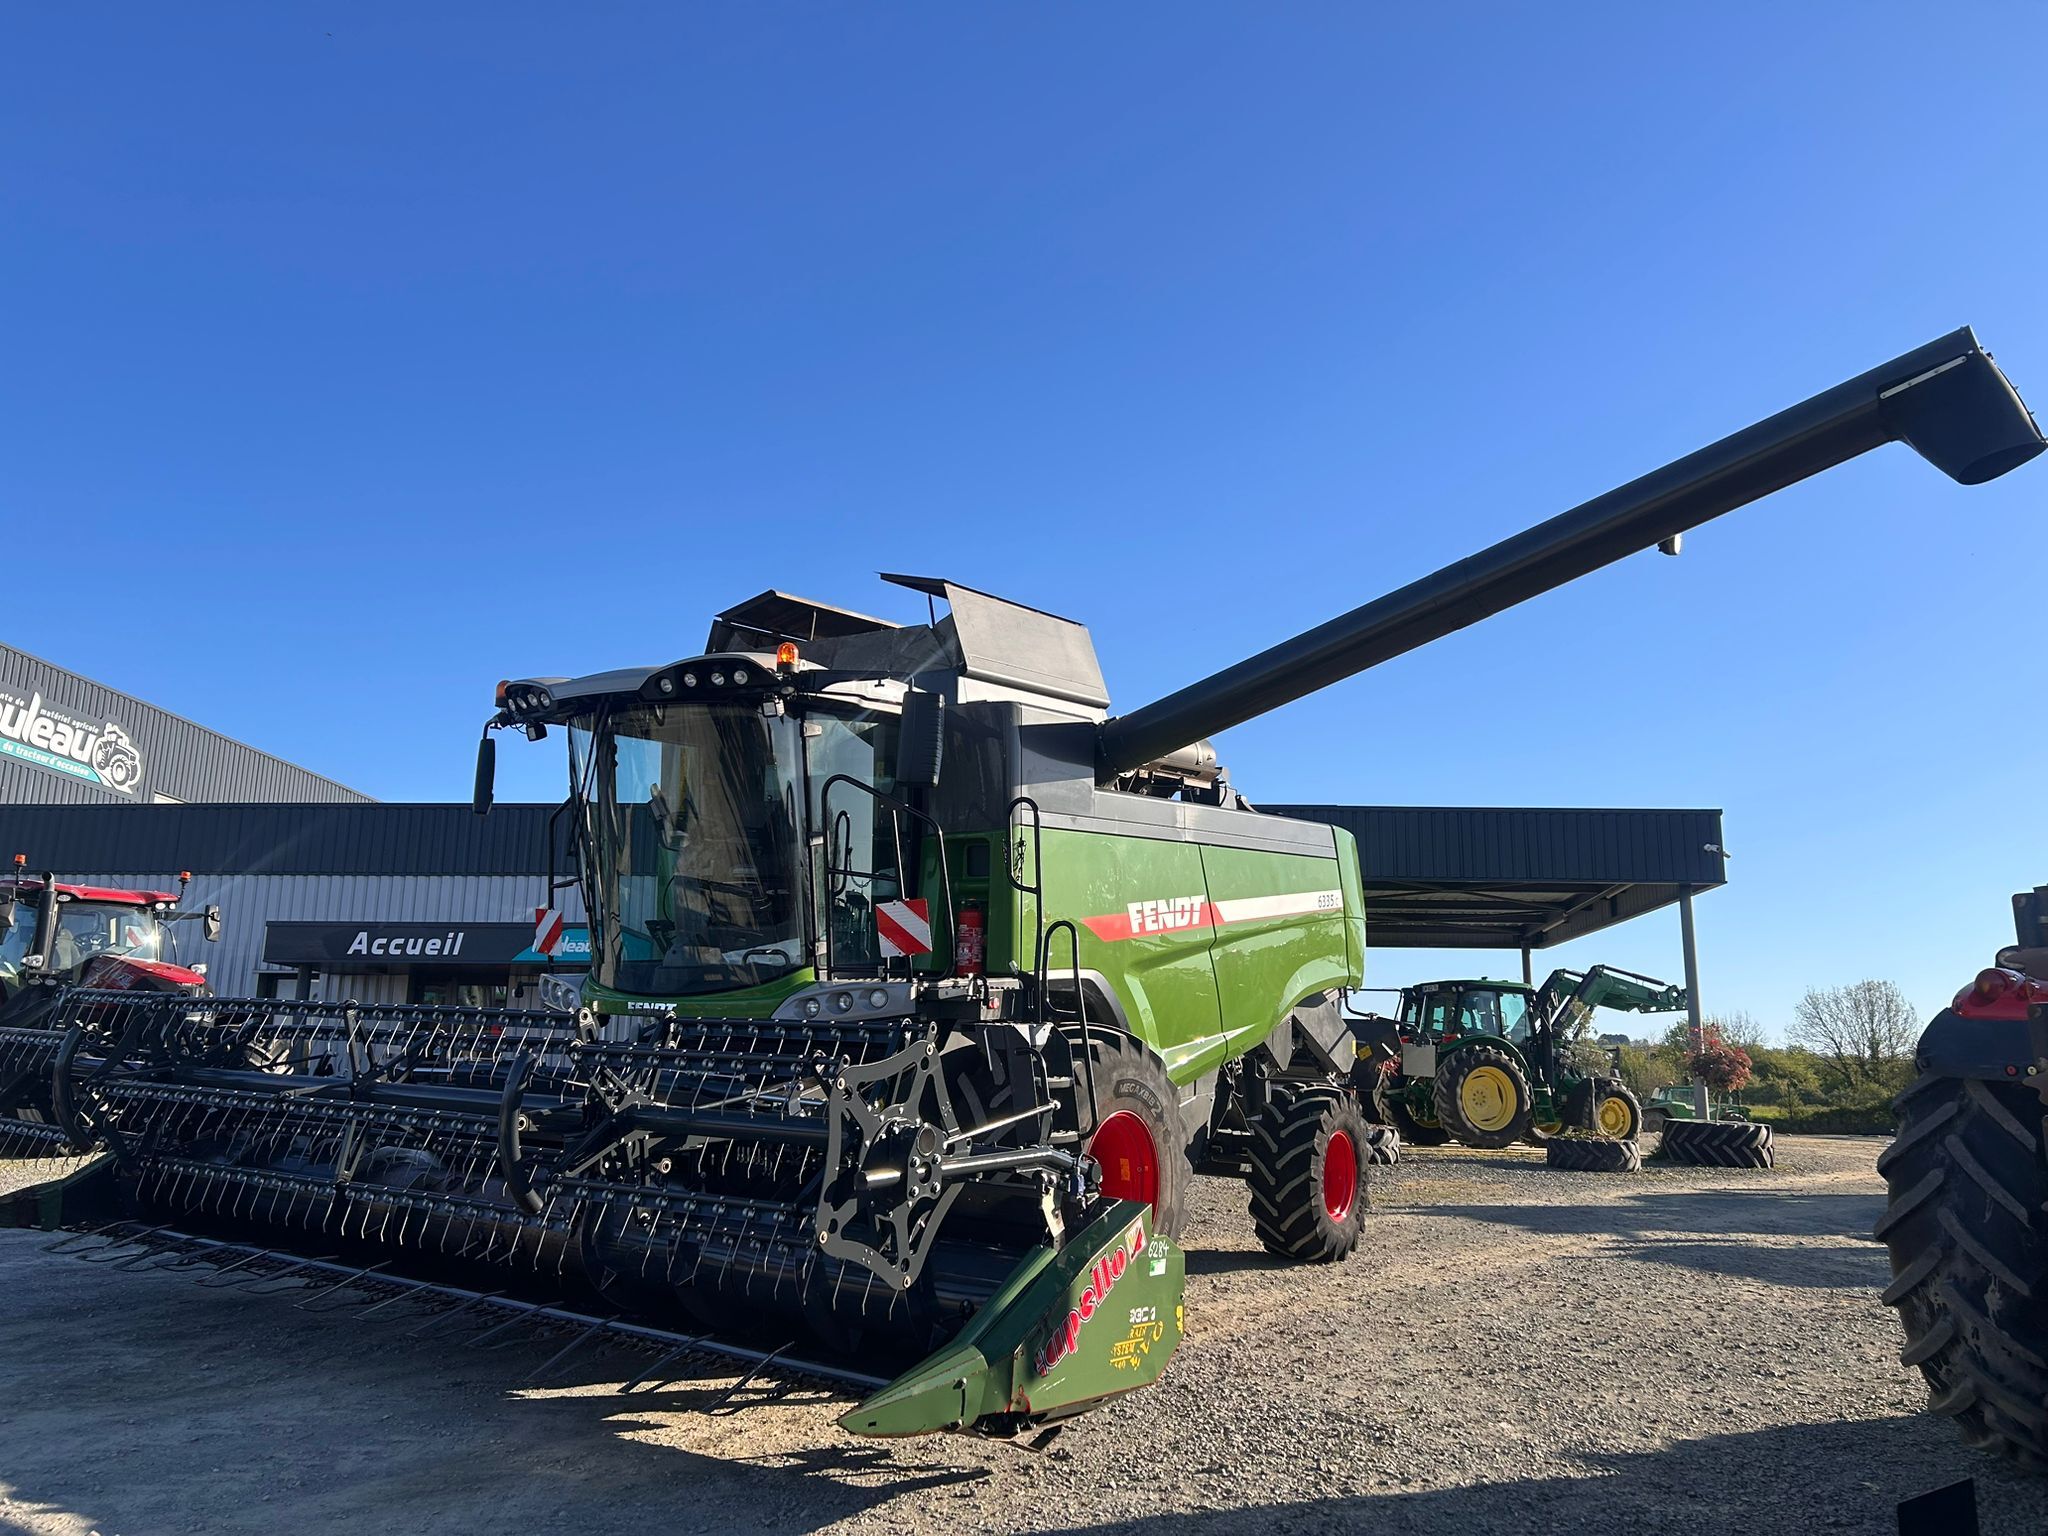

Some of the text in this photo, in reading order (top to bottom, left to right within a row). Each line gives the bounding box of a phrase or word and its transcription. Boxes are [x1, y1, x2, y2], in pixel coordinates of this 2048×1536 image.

[0, 691, 98, 763] uleau
[1127, 895, 1206, 933] FENDT
[1318, 894, 1334, 908] 6335
[346, 931, 465, 956] Accueil
[1148, 1240, 1169, 1258] 6284
[1035, 1245, 1127, 1377] apello
